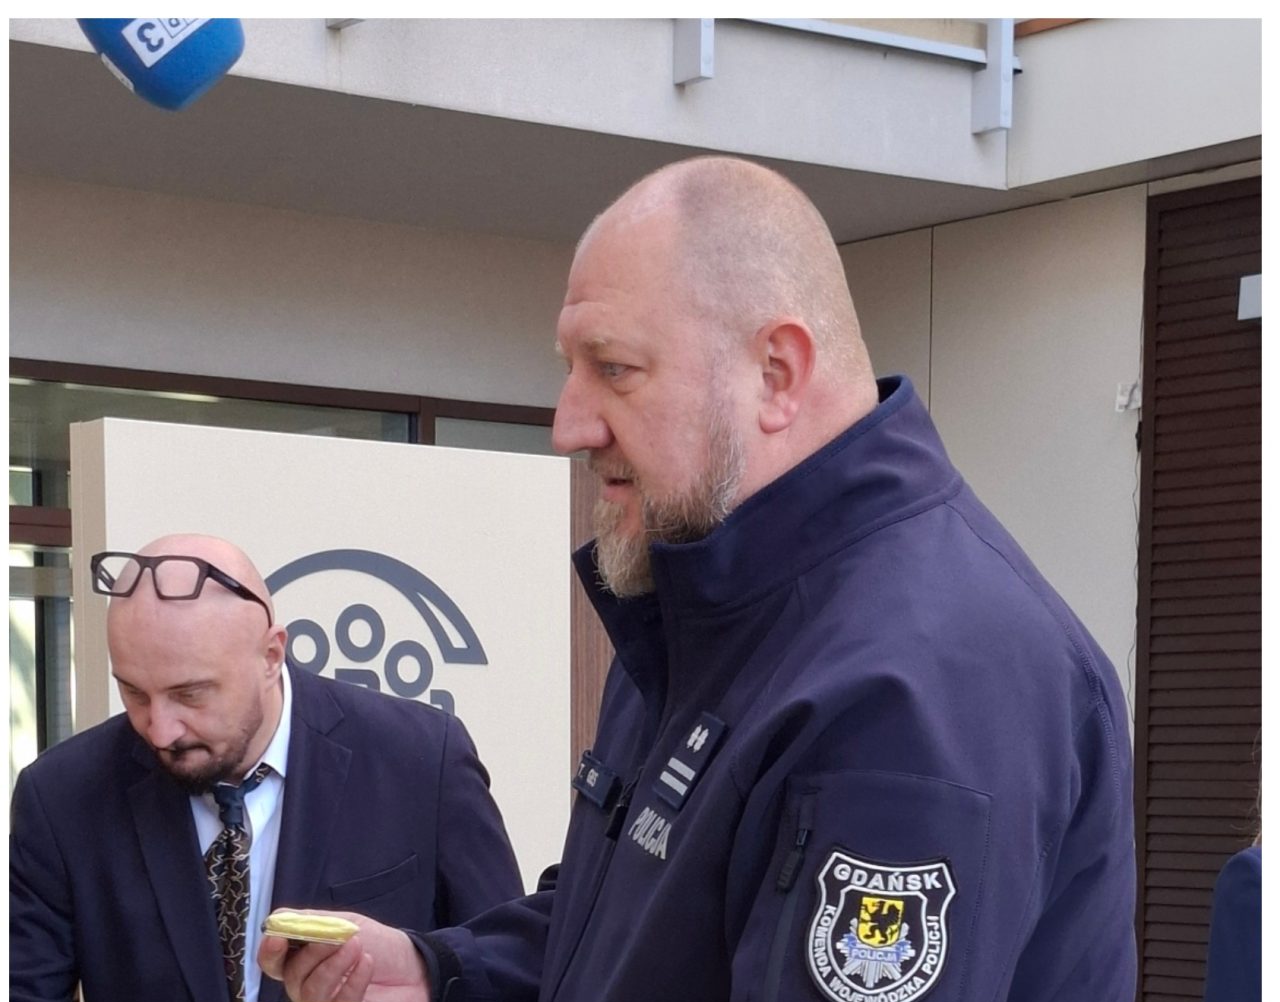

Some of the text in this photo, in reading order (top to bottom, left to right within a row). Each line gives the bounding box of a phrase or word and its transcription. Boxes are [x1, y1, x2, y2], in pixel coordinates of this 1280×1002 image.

[833, 863, 943, 891] GDAŃSK
[813, 904, 837, 978] KOMENDA
[921, 915, 942, 976] POLICJI
[851, 948, 898, 961] POLICJA
